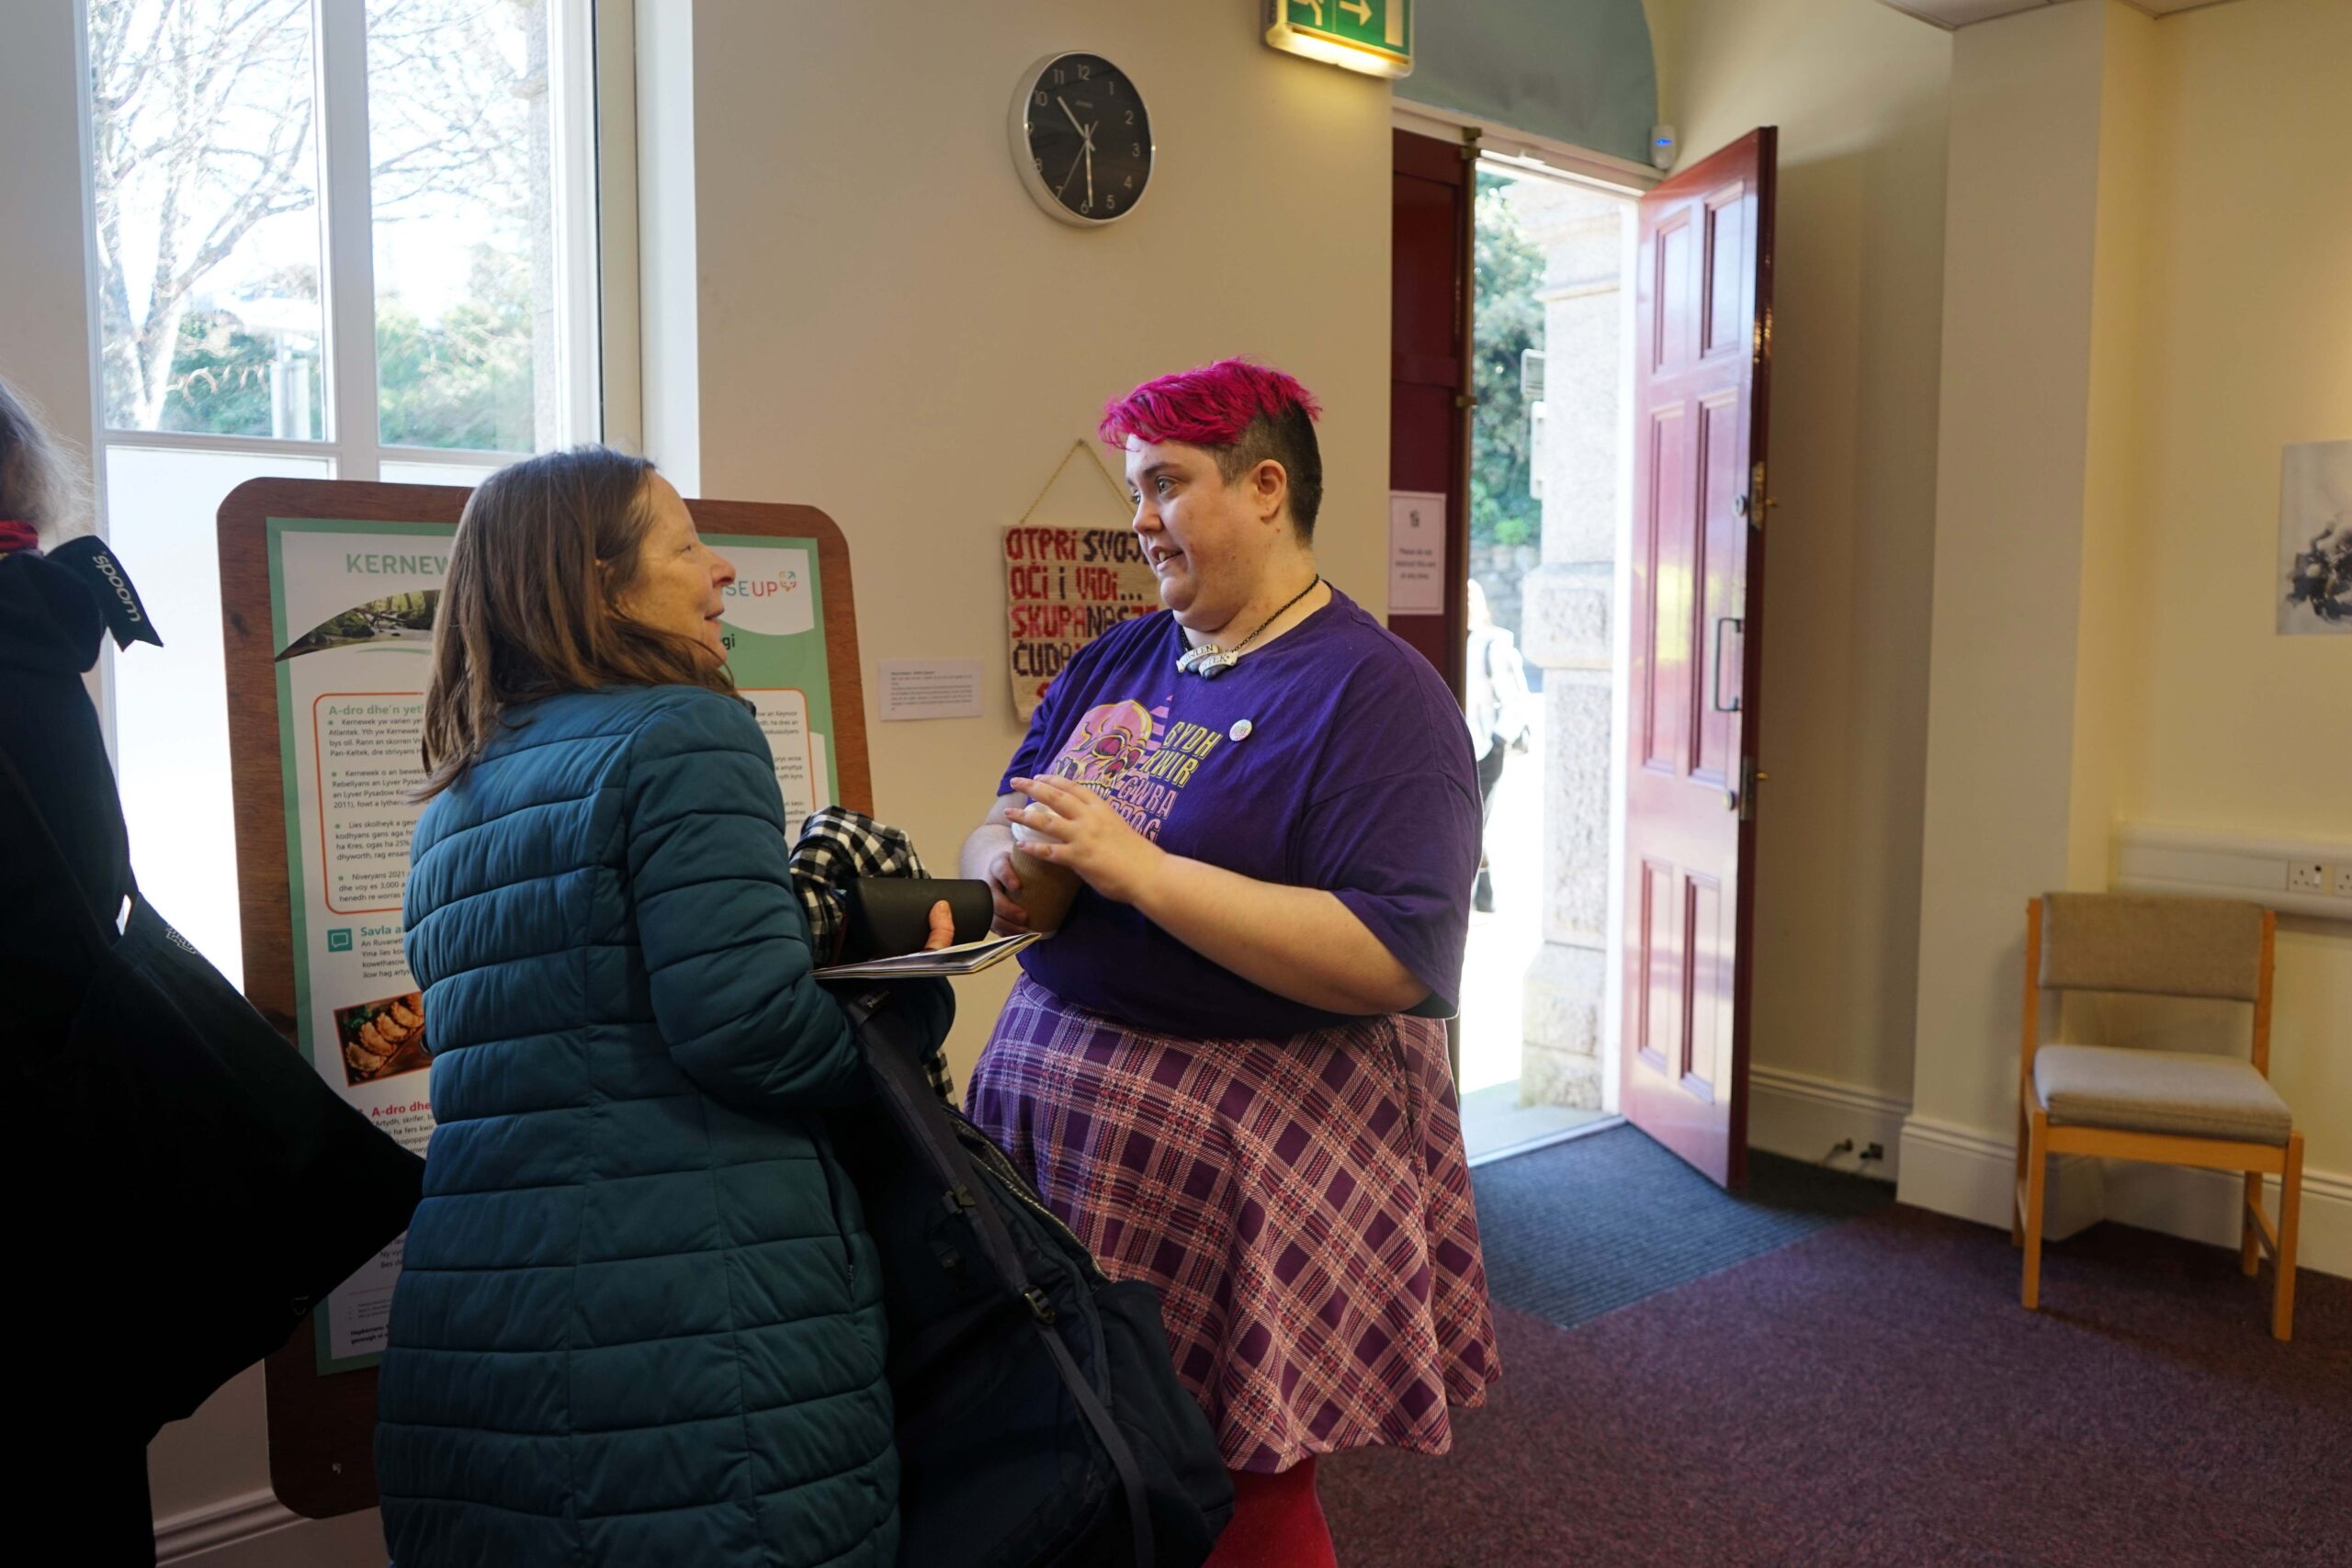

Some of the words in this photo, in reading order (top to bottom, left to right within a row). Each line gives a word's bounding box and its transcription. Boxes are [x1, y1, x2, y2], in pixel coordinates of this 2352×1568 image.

[1053, 69, 1064, 85] 11
[1077, 64, 1090, 80] 12
[1108, 81, 1114, 96] 1
[1035, 91, 1047, 106] 10
[1125, 110, 1133, 125] 2
[1132, 142, 1140, 157] 3
[1124, 175, 1132, 189] 4
[1080, 199, 1089, 214] 6
[1106, 195, 1114, 209] 5
[329, 705, 363, 716] A-dro
[402, 704, 424, 716] yet
[360, 925, 391, 936] Savla
[372, 1105, 406, 1117] A-dro
